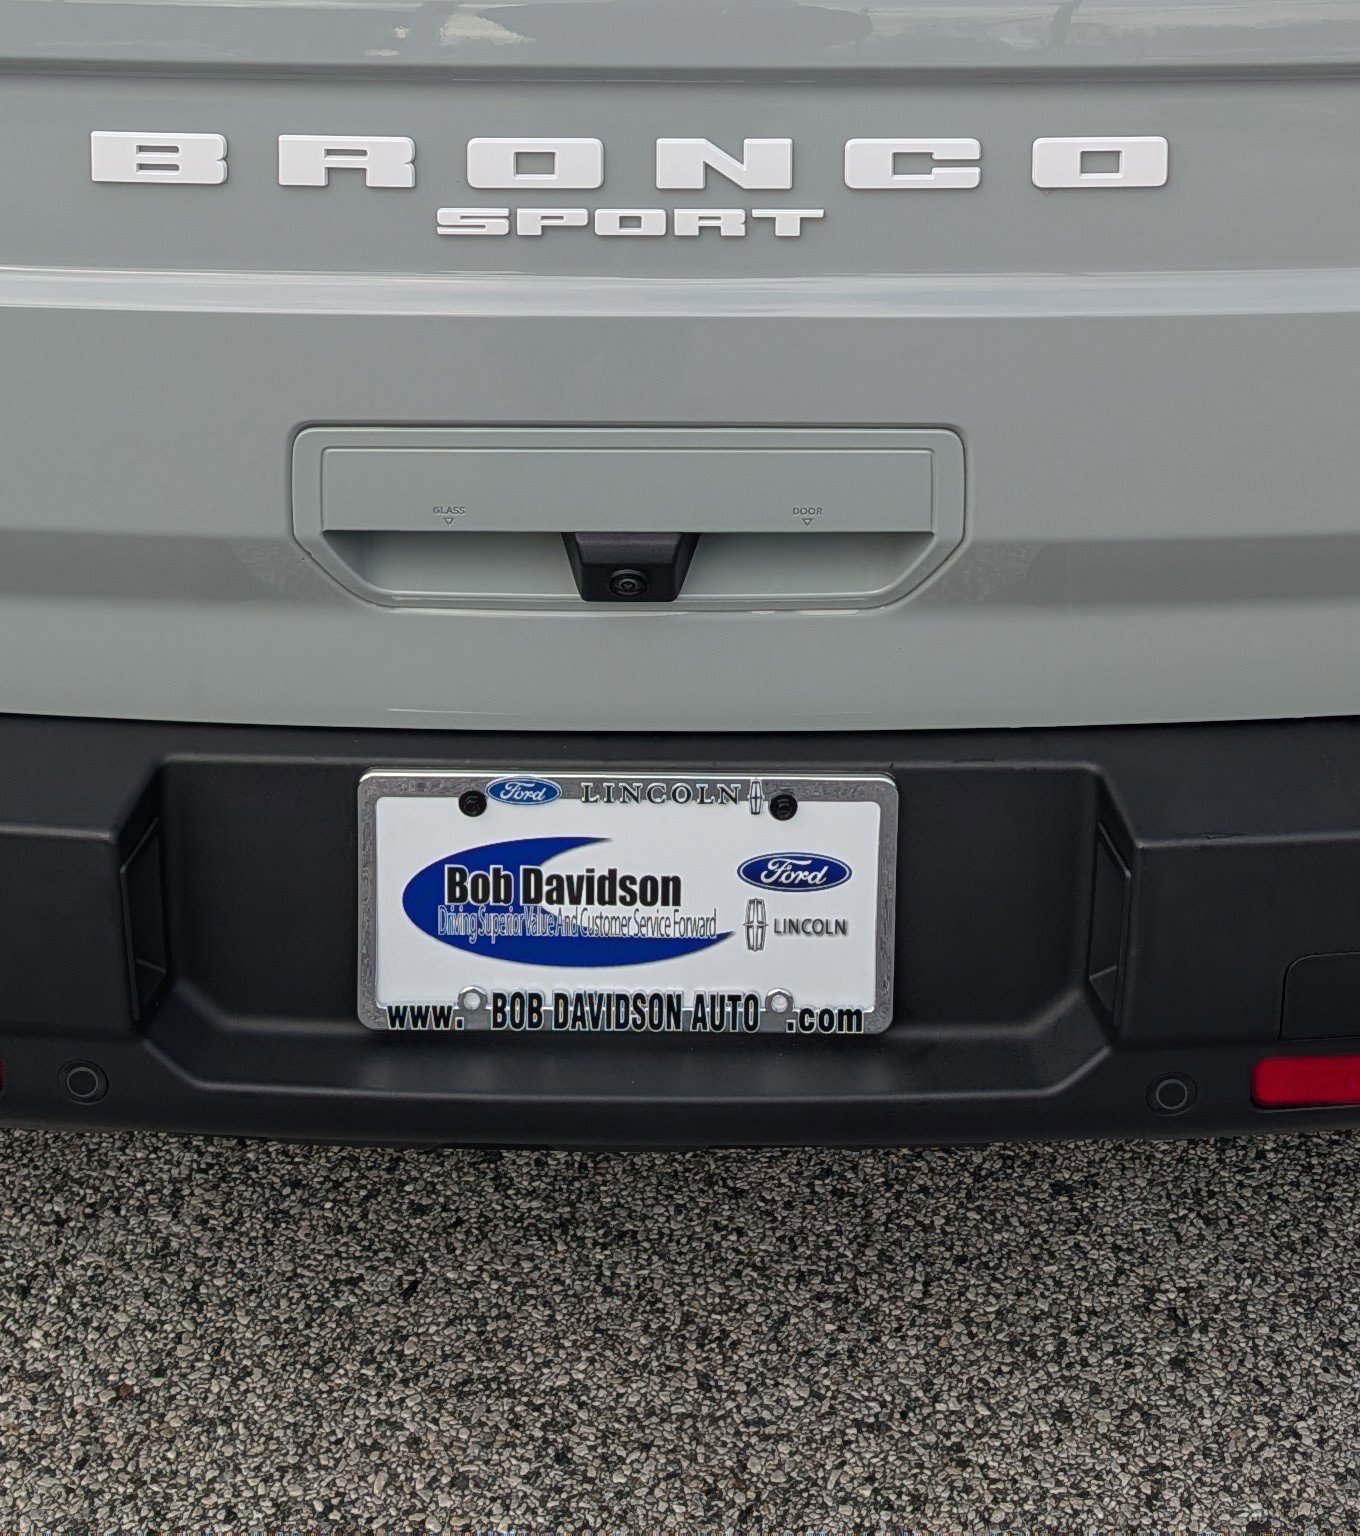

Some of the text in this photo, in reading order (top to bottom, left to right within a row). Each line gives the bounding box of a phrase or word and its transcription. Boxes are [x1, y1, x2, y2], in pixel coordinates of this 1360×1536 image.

[90, 130, 1169, 191] BRONCO
[435, 206, 824, 238] SPORT
[432, 505, 466, 516] GLASS
[792, 506, 824, 516] DOOR
[580, 781, 742, 805] LINCOLN
[444, 864, 683, 907] Bob Davidson
[438, 905, 717, 943] Driving Superior Value And Customer Service Forward
[773, 917, 848, 936] LINCOLN
[386, 990, 865, 1034] www. BOB DAVIDSON AUTO .com
